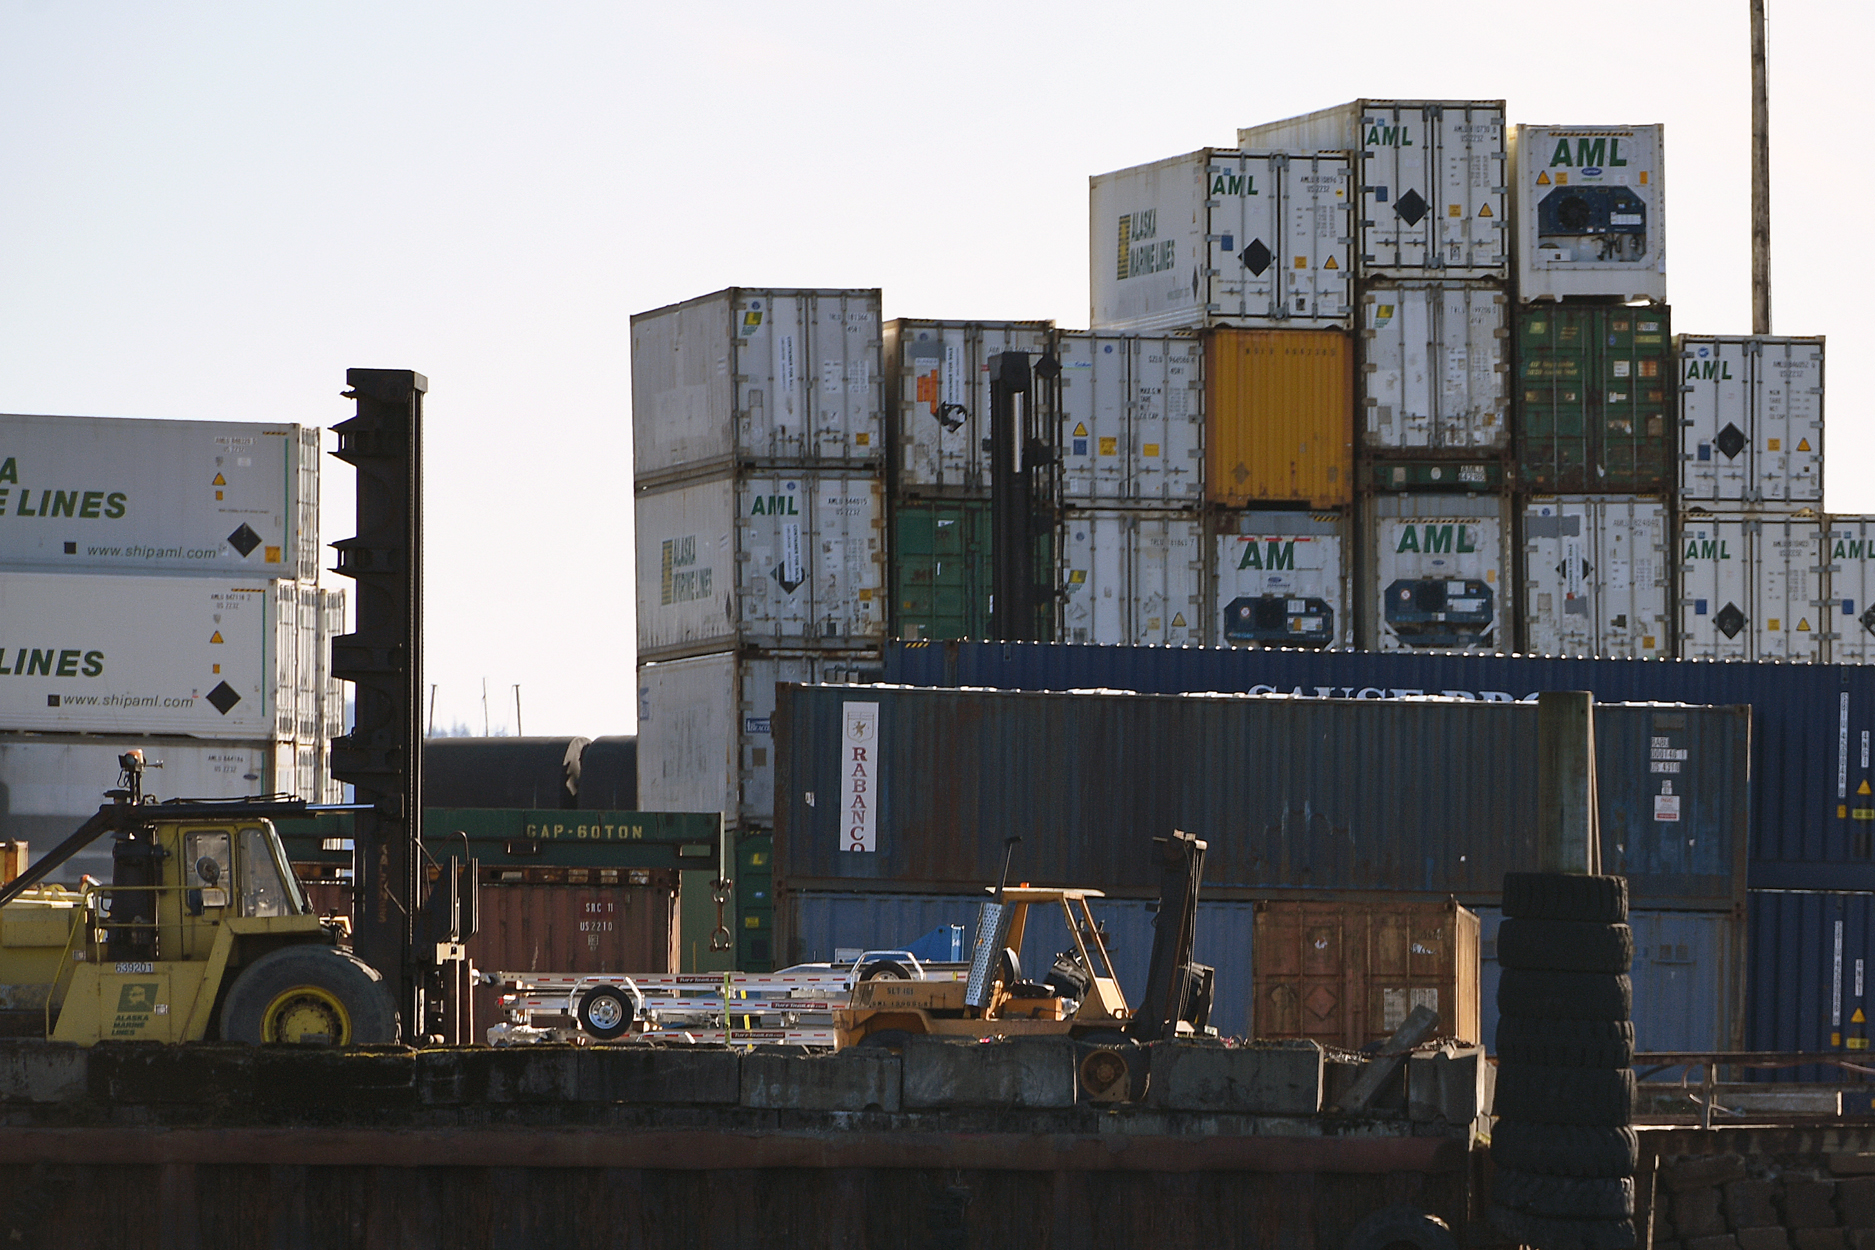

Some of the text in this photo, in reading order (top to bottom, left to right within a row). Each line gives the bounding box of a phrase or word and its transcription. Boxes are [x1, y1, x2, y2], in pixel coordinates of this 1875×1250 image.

[1366, 126, 1413, 146] AML
[1549, 138, 1627, 167] AML
[1211, 175, 1259, 195] AML
[1686, 360, 1732, 380] AML
[17, 489, 127, 519] LINES
[751, 495, 799, 515] AML
[1396, 525, 1475, 553] AML
[87, 544, 216, 560] www.shipaml.com
[1685, 540, 1730, 559] AML
[64, 694, 194, 708] www.shipaml.com
[850, 747, 868, 852] RABANCO
